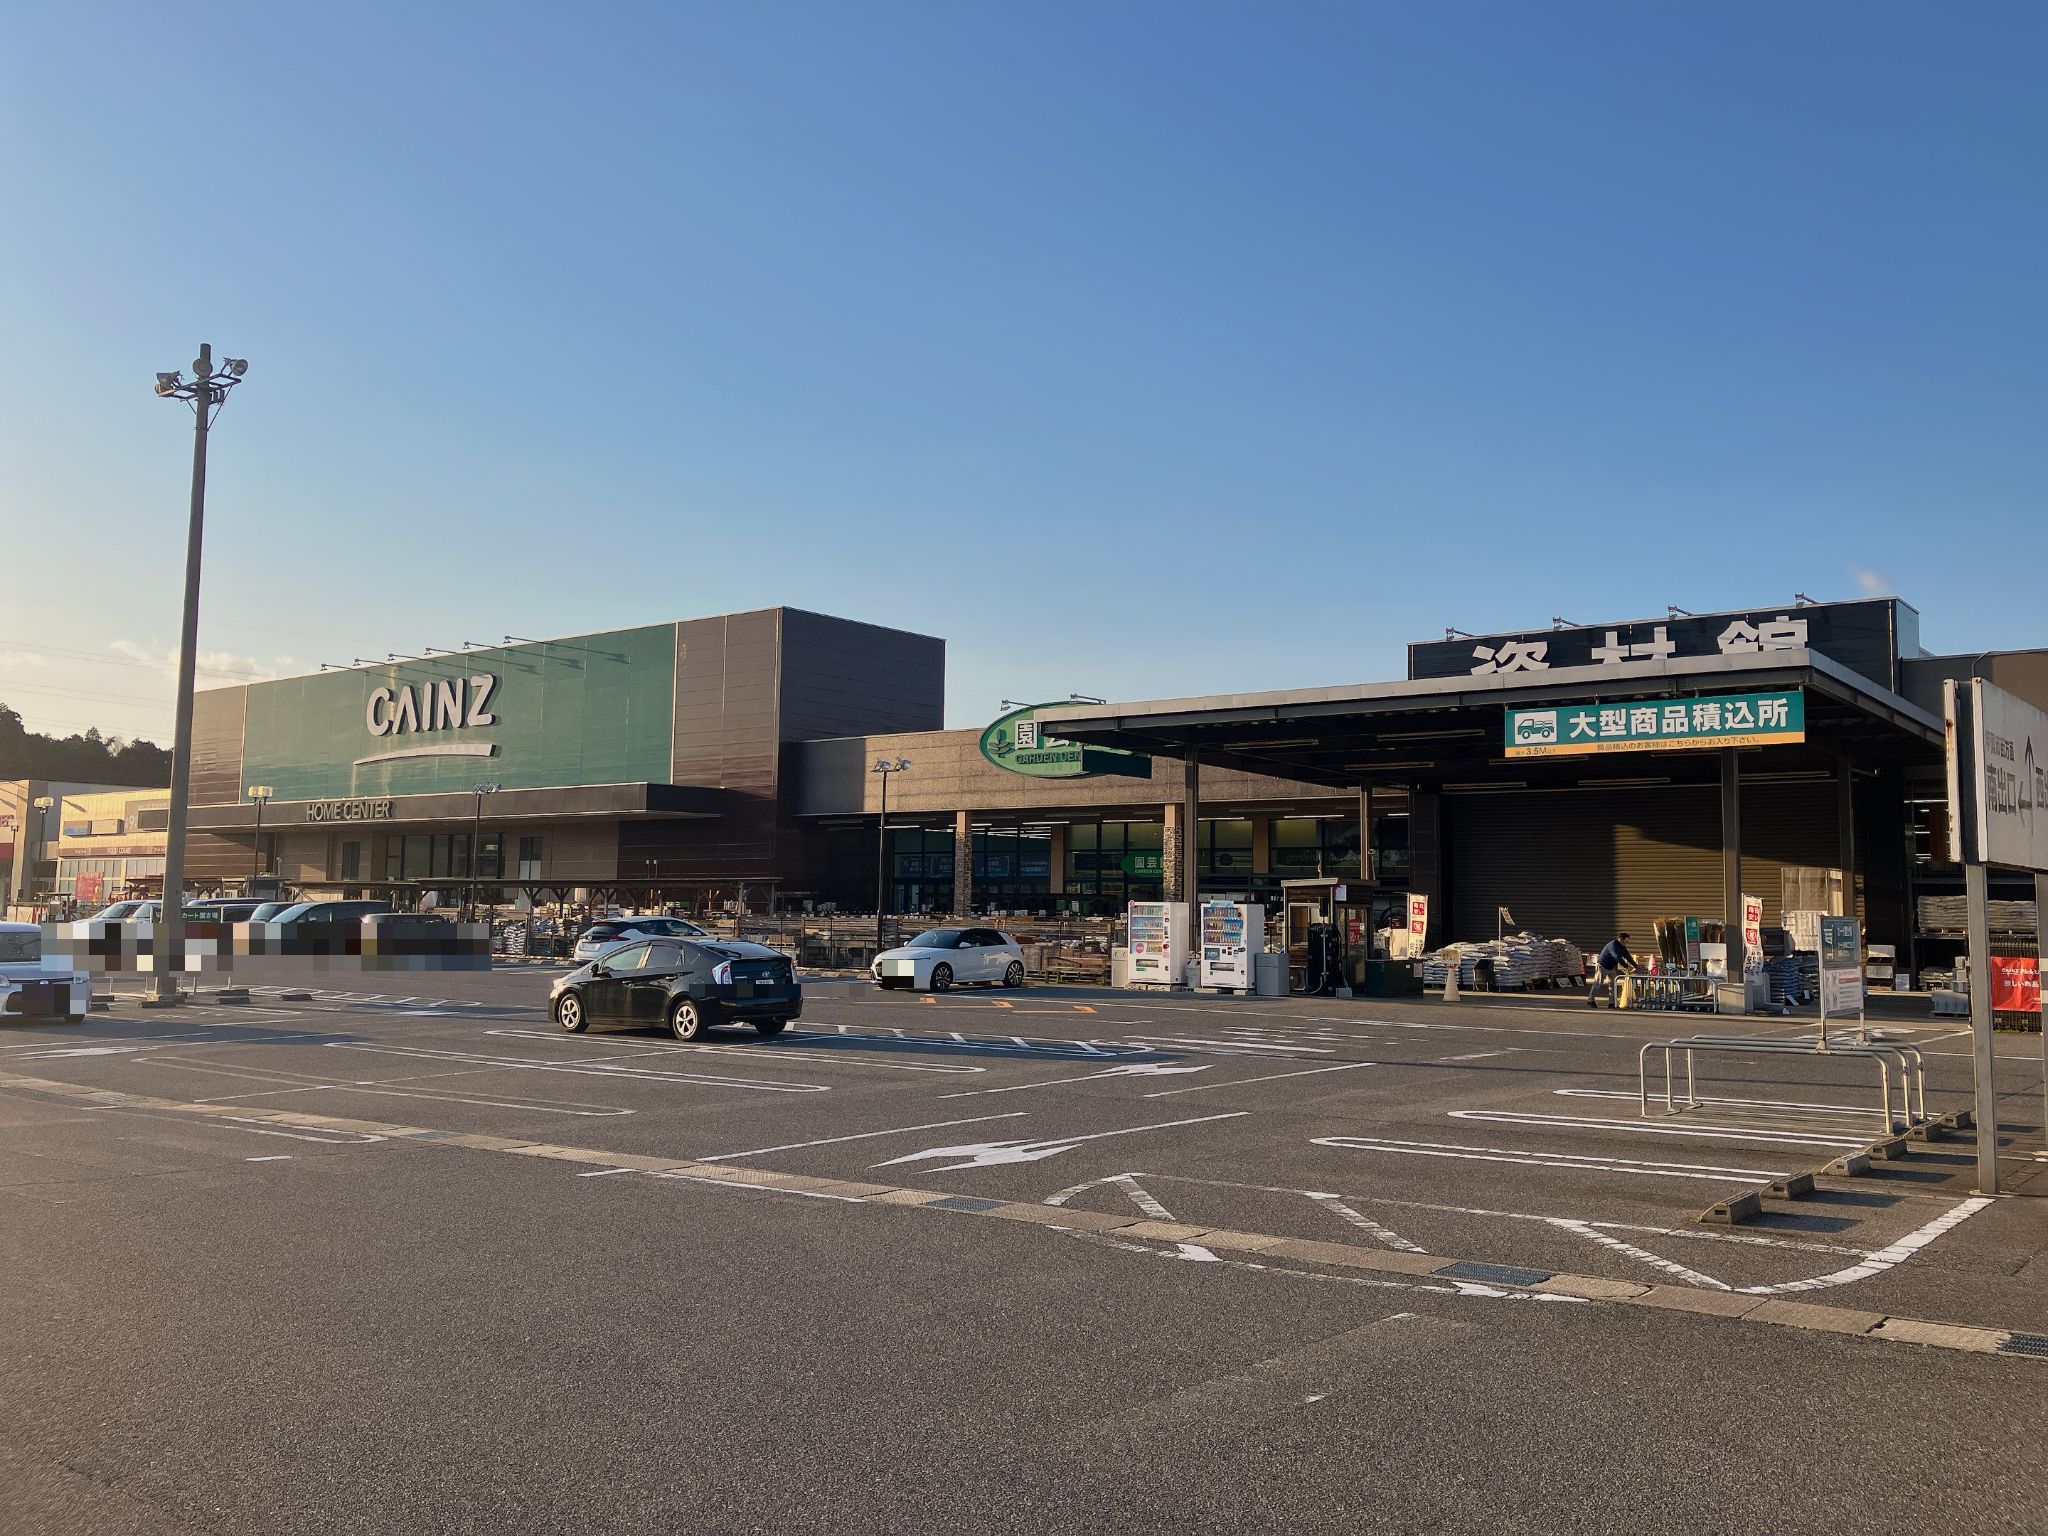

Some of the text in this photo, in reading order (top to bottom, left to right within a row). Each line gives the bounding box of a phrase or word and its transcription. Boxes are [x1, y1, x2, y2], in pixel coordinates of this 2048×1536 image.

[367, 673, 495, 736] CAINZ
[1569, 697, 1788, 739] 大型商品積込所
[1016, 752, 1057, 764] GARDEN
[306, 800, 390, 821] HOME CENTER
